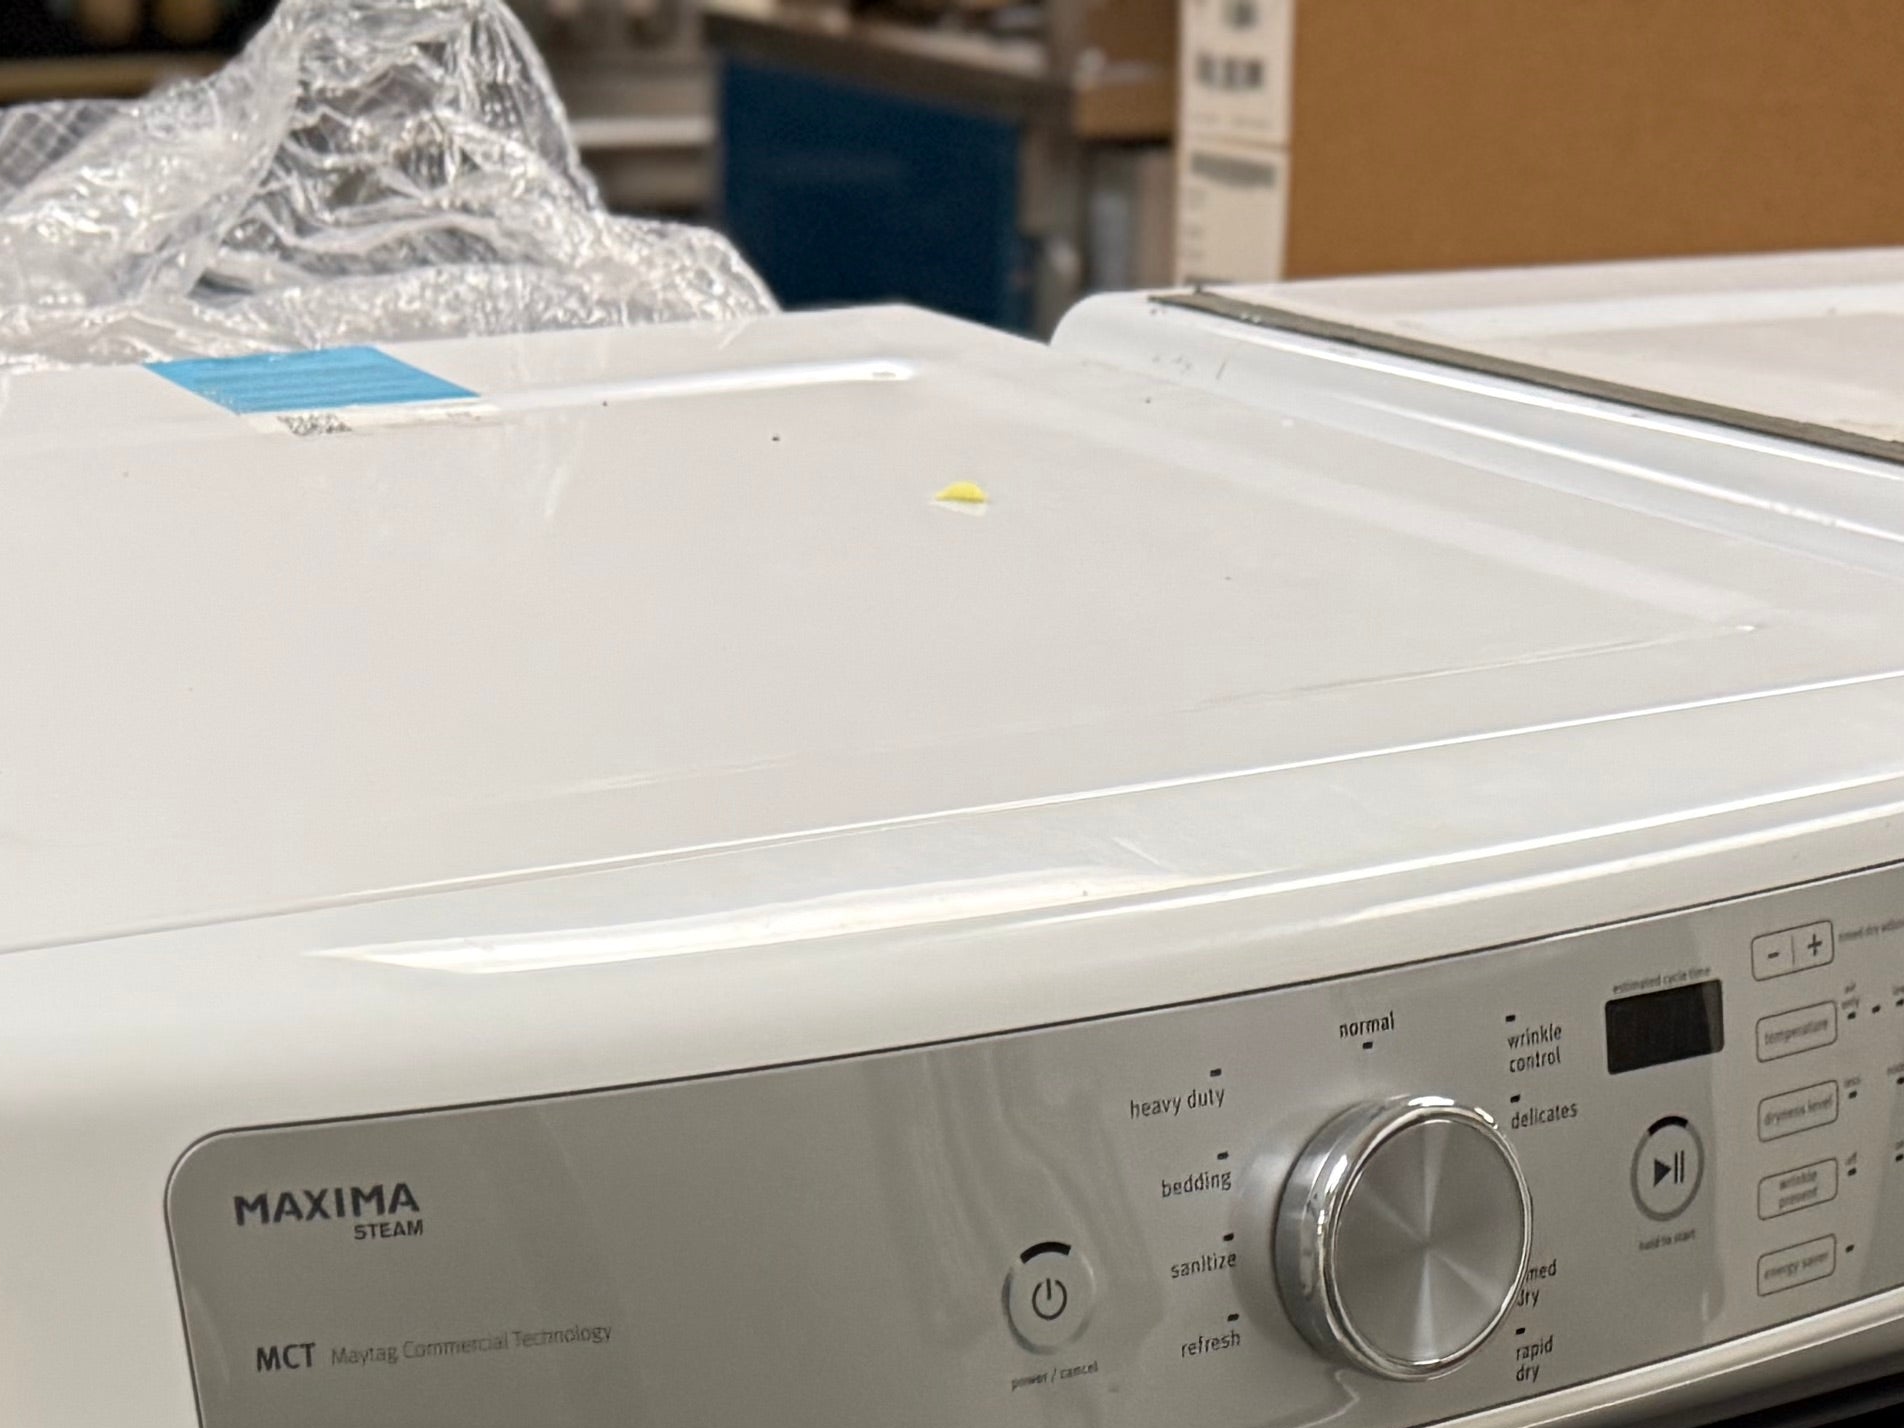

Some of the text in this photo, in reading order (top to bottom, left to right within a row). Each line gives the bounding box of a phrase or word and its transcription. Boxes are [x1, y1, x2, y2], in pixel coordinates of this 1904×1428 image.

[1338, 1010, 1396, 1039] normal
[1507, 1023, 1563, 1050] wrinkle
[1509, 1045, 1561, 1074] control
[1129, 1085, 1226, 1122] heavy duty
[1511, 1103, 1579, 1130] delicates
[1161, 1168, 1233, 1199] bedding
[232, 1181, 421, 1227] MAXIMA
[353, 1218, 424, 1241] STEAM
[1171, 1248, 1238, 1280] sanitize
[255, 1322, 613, 1373] MCT Maytag Commercial Technology
[1181, 1328, 1242, 1358] refresh
[1516, 1334, 1553, 1362] rapid
[1516, 1363, 1540, 1383] dry
